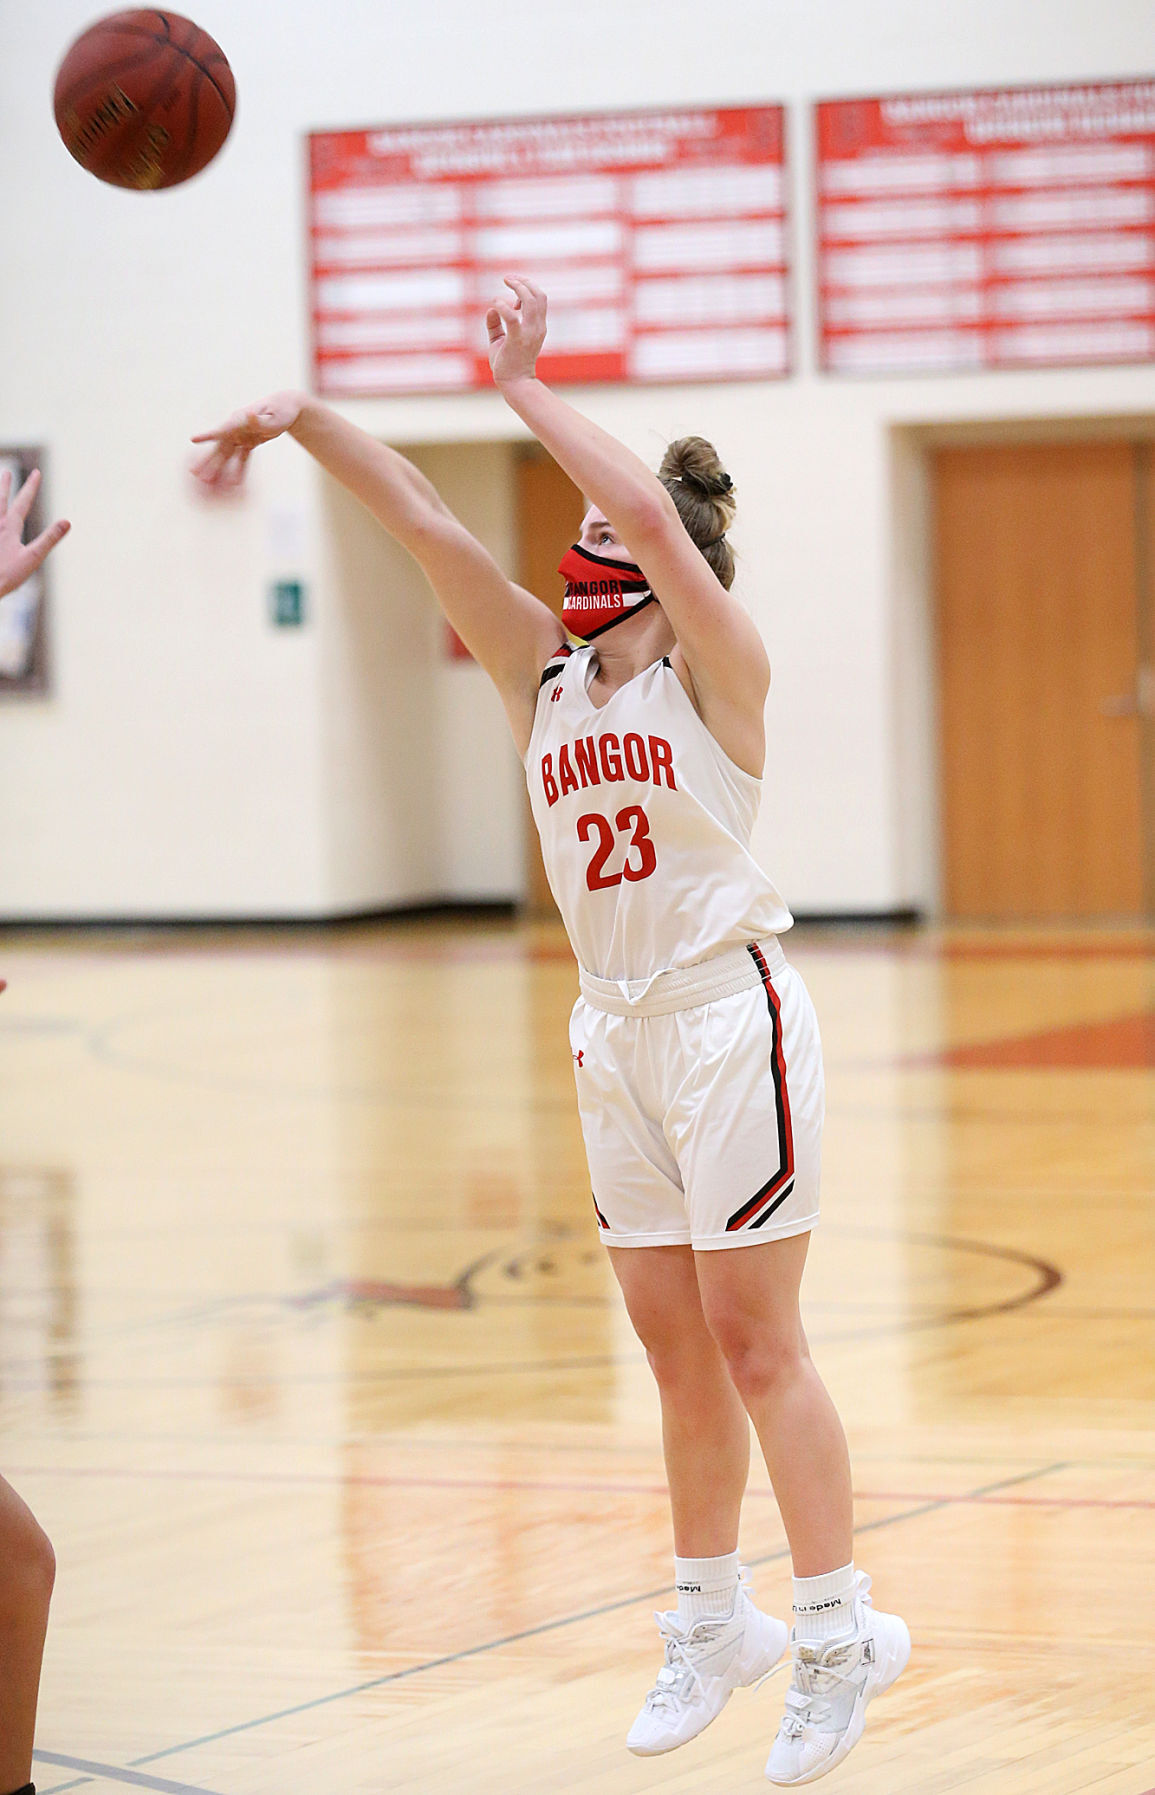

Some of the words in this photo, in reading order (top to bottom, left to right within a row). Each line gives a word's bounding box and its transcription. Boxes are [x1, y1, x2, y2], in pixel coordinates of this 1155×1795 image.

[541, 732, 679, 808] BANGOR
[576, 805, 657, 891] 23
[809, 1598, 842, 1611] Made
